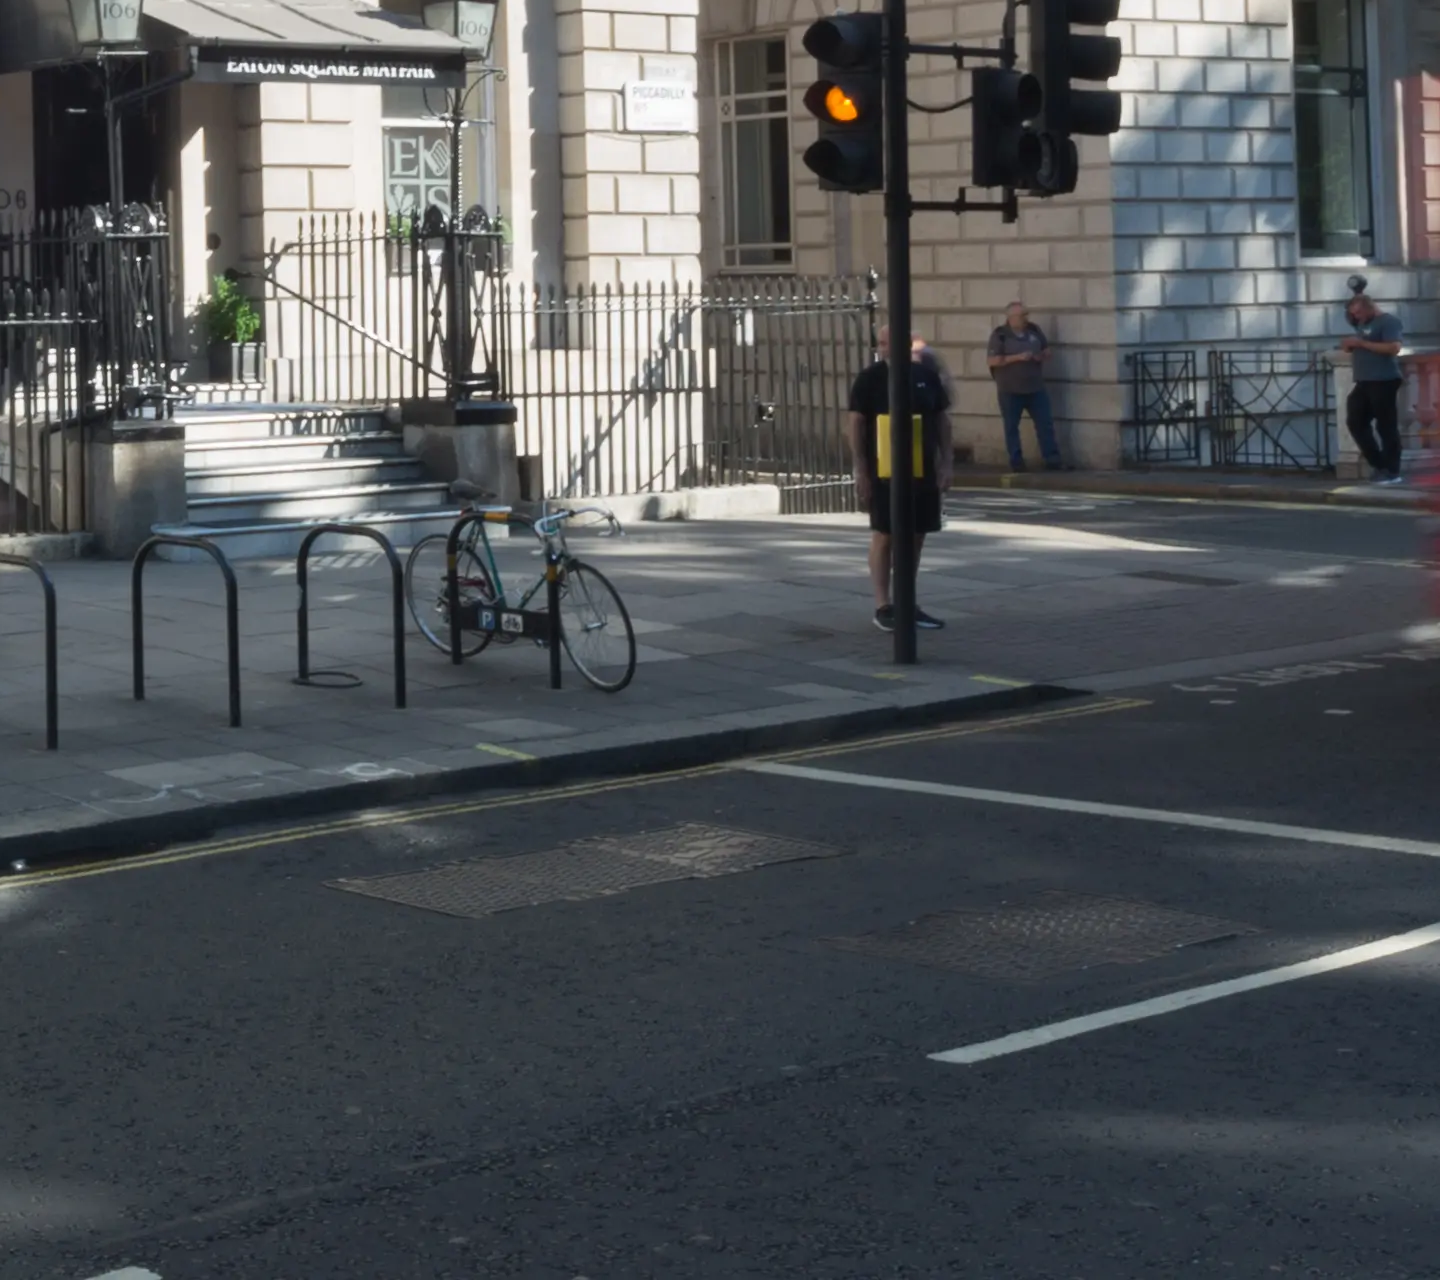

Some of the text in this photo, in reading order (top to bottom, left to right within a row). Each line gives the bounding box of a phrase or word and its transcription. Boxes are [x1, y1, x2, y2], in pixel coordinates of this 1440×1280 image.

[103, 2, 136, 20] 106
[460, 20, 488, 36] 106
[226, 55, 437, 79] EATON SQUARE MAYFAIR
[632, 86, 685, 100] PICCADILLY
[390, 138, 419, 176] E
[481, 611, 492, 628] P
